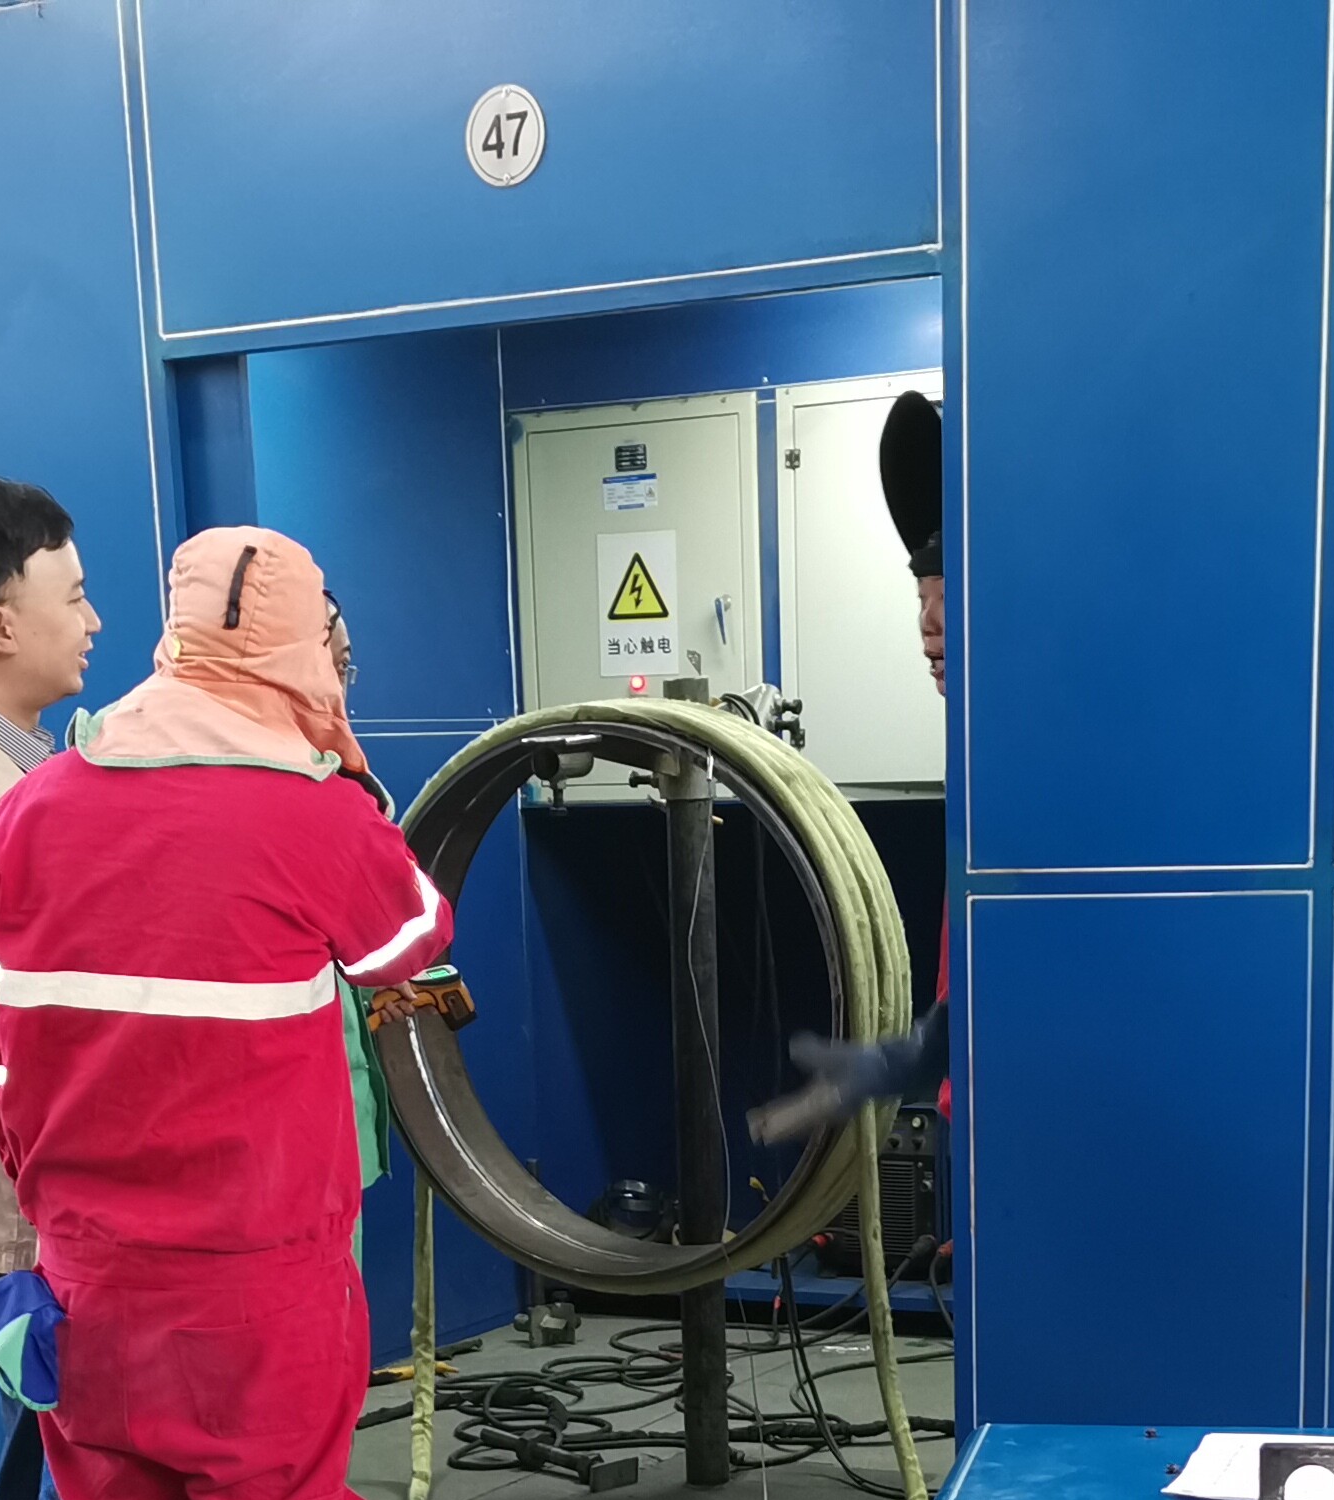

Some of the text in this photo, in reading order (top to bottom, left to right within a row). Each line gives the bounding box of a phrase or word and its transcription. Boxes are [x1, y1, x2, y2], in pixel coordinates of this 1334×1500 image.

[481, 109, 528, 159] 47
[607, 637, 672, 656] 当心触电
